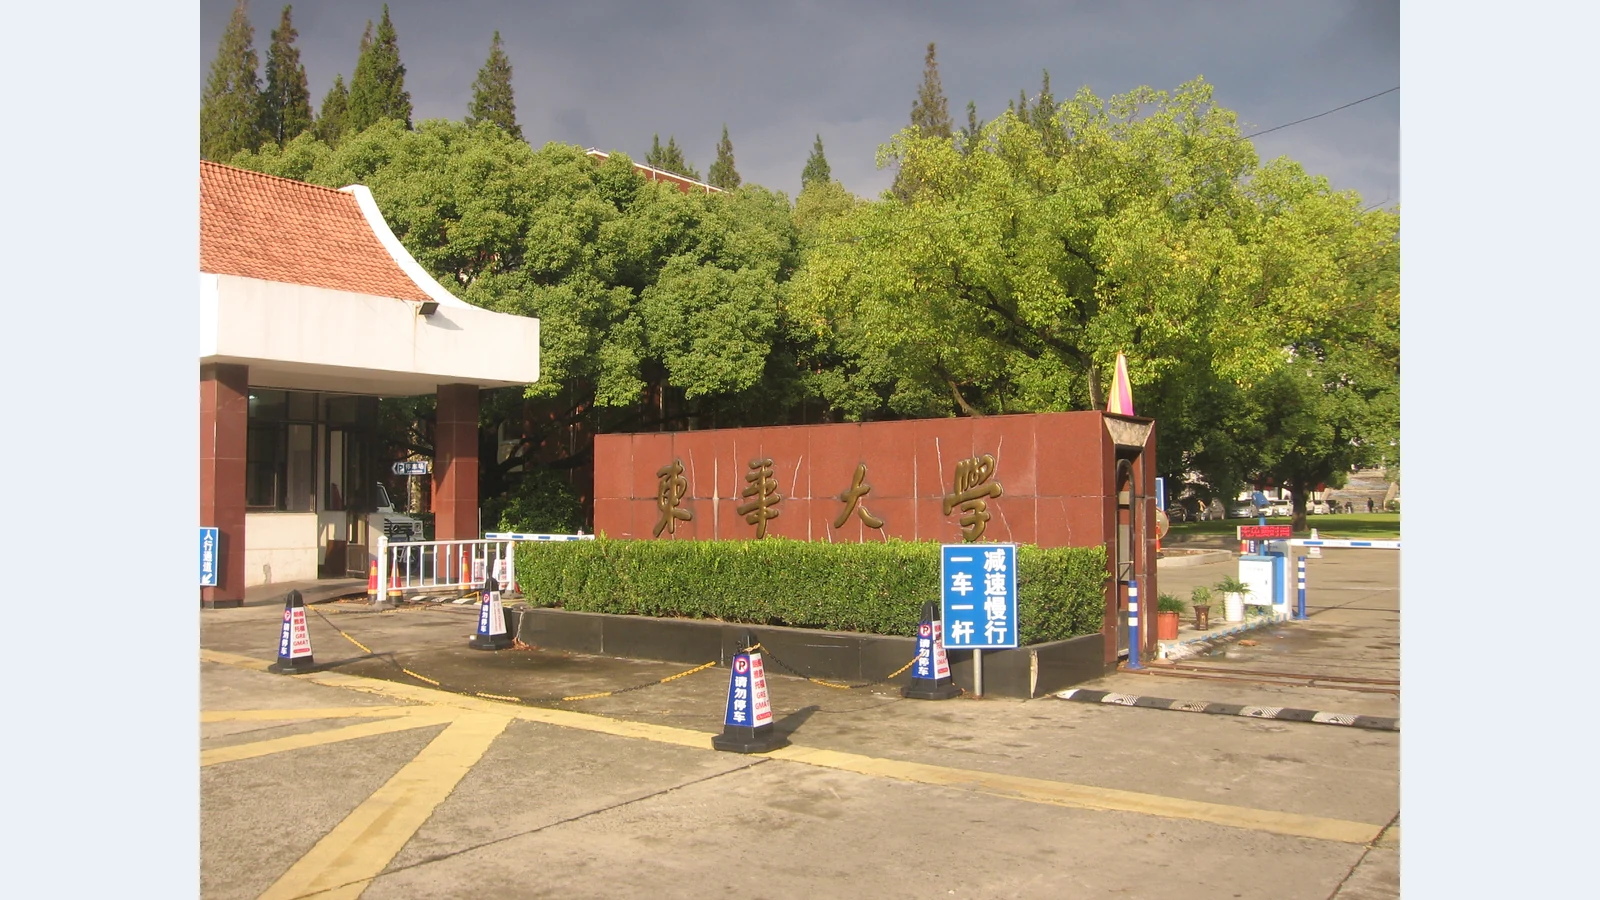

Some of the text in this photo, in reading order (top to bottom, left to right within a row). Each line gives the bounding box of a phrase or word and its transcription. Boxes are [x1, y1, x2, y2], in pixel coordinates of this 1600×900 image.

[202, 528, 214, 573] 人行通道
[950, 556, 975, 645] 一车一杆
[983, 548, 1008, 645] 减速慢行
[280, 622, 290, 656] 请勿停车
[918, 638, 930, 676] 请勿停车
[733, 676, 748, 723] 请勿停车
[755, 700, 770, 710] GMAT
[757, 690, 766, 699] GRE
